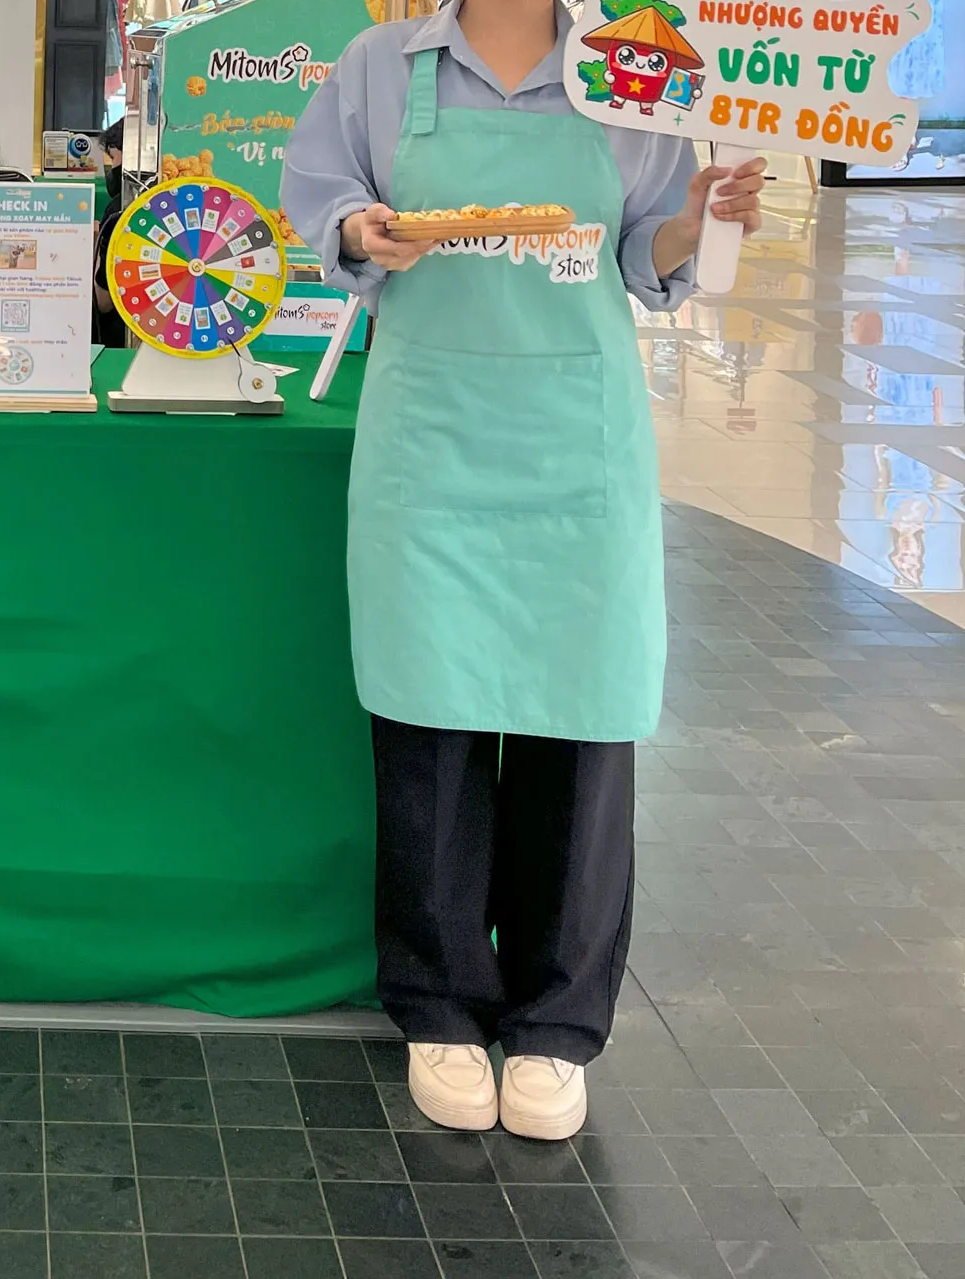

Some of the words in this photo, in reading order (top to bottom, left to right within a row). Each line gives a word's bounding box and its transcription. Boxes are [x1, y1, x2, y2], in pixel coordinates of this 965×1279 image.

[699, 0, 803, 32] NHƯỢNG
[813, 4, 899, 36] QUYỀN
[718, 37, 800, 87] VỐN
[817, 48, 876, 94] TỪ
[709, 94, 781, 135] 8TR
[795, 101, 893, 152] ĐỒNG
[34, 200, 47, 211] IN
[514, 229, 601, 259] popcorn
[557, 254, 594, 277] store
